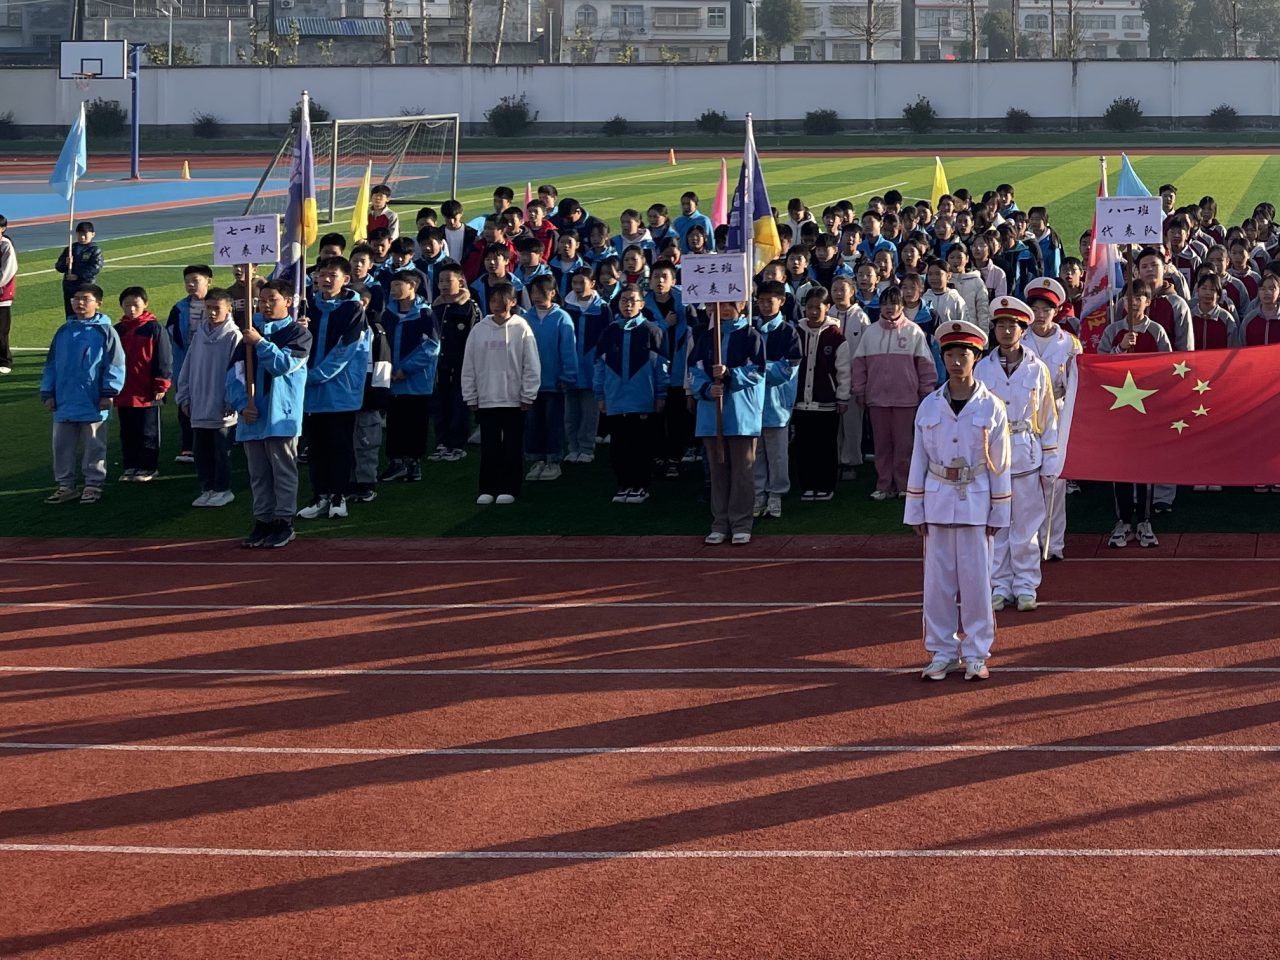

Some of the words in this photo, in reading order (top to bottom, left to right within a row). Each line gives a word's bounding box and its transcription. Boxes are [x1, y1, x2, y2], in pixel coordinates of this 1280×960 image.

[1108, 204, 1149, 216] 八一班
[226, 223, 266, 236] 七一班
[1101, 223, 1158, 238] 代表队
[219, 242, 275, 257] 代表队
[693, 261, 733, 274] 七三班
[686, 282, 742, 296] 代表队
